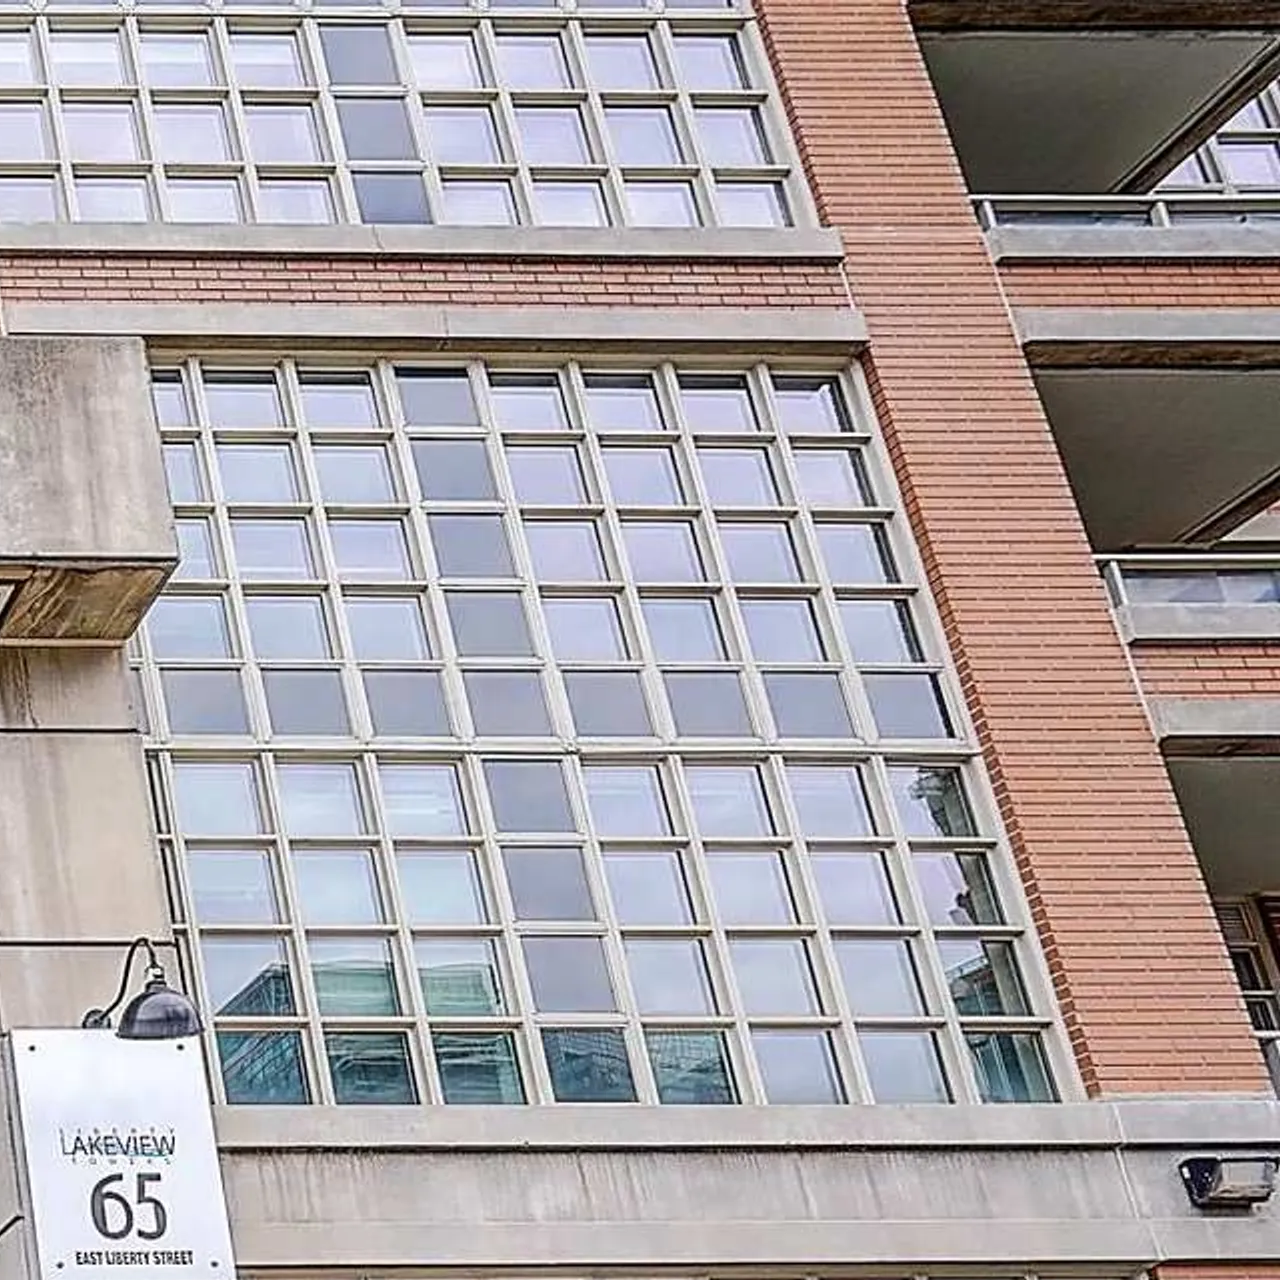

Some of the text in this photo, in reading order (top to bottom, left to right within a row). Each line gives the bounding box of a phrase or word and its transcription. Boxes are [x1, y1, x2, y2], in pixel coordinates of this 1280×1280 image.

[59, 1133, 176, 1156] LAKEVIEW
[90, 1171, 167, 1240] 65
[75, 1250, 194, 1266] EAST LIBERTY STREET
